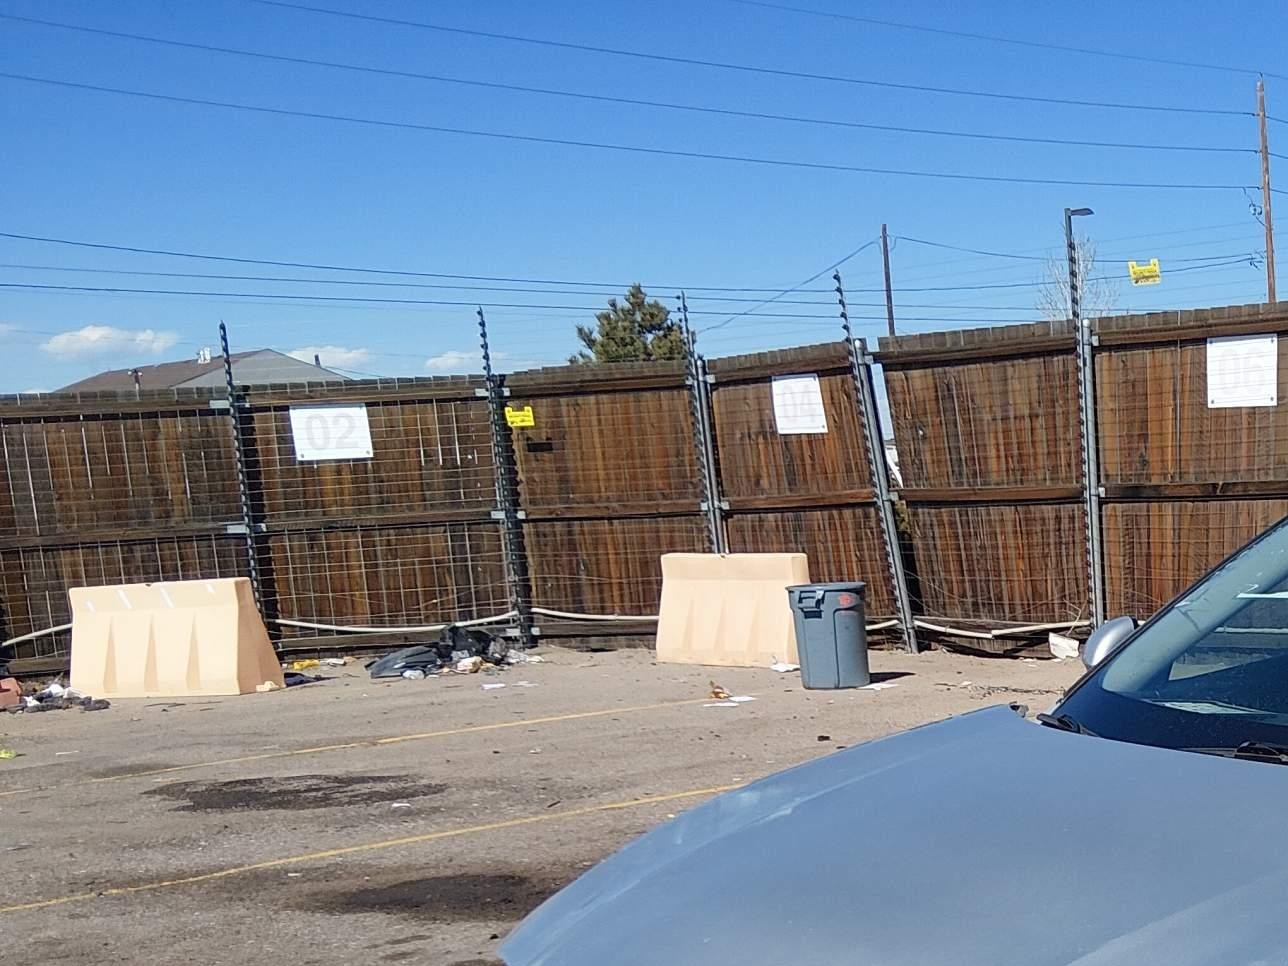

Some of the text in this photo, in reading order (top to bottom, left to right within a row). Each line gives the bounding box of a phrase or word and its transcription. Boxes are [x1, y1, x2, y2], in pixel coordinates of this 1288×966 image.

[1219, 347, 1266, 395] 06
[782, 384, 818, 424] 04
[305, 412, 358, 450] 02
